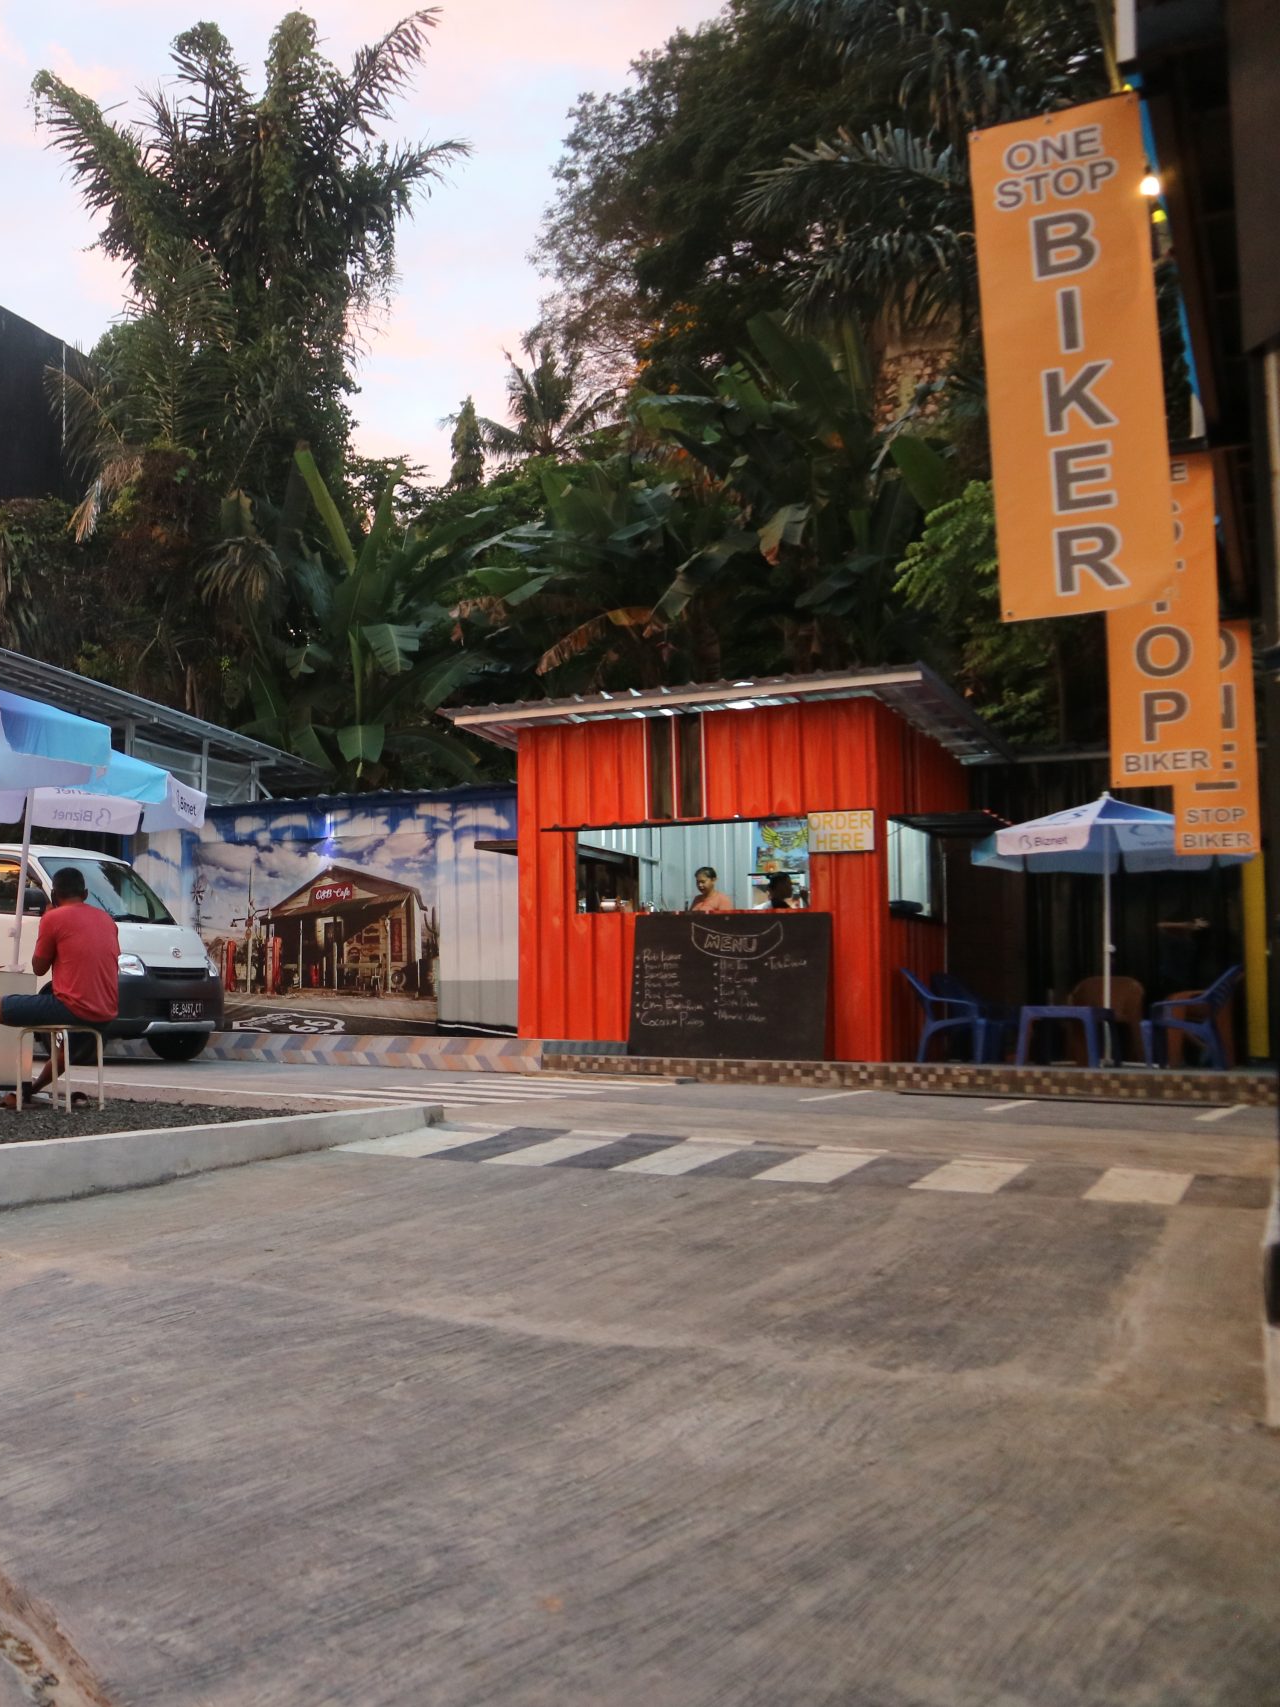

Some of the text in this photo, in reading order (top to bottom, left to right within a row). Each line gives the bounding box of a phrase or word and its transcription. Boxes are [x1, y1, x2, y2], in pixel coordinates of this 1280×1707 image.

[1005, 126, 1103, 173] ONE
[995, 158, 1118, 210] STOP
[1029, 209, 1131, 597] BIKER
[1123, 750, 1210, 773] BIKER
[808, 813, 872, 830] ORDER
[1186, 807, 1247, 825] STOP
[815, 833, 865, 850] HERE
[1182, 832, 1252, 850] BIKER
[703, 933, 758, 952] MENU
